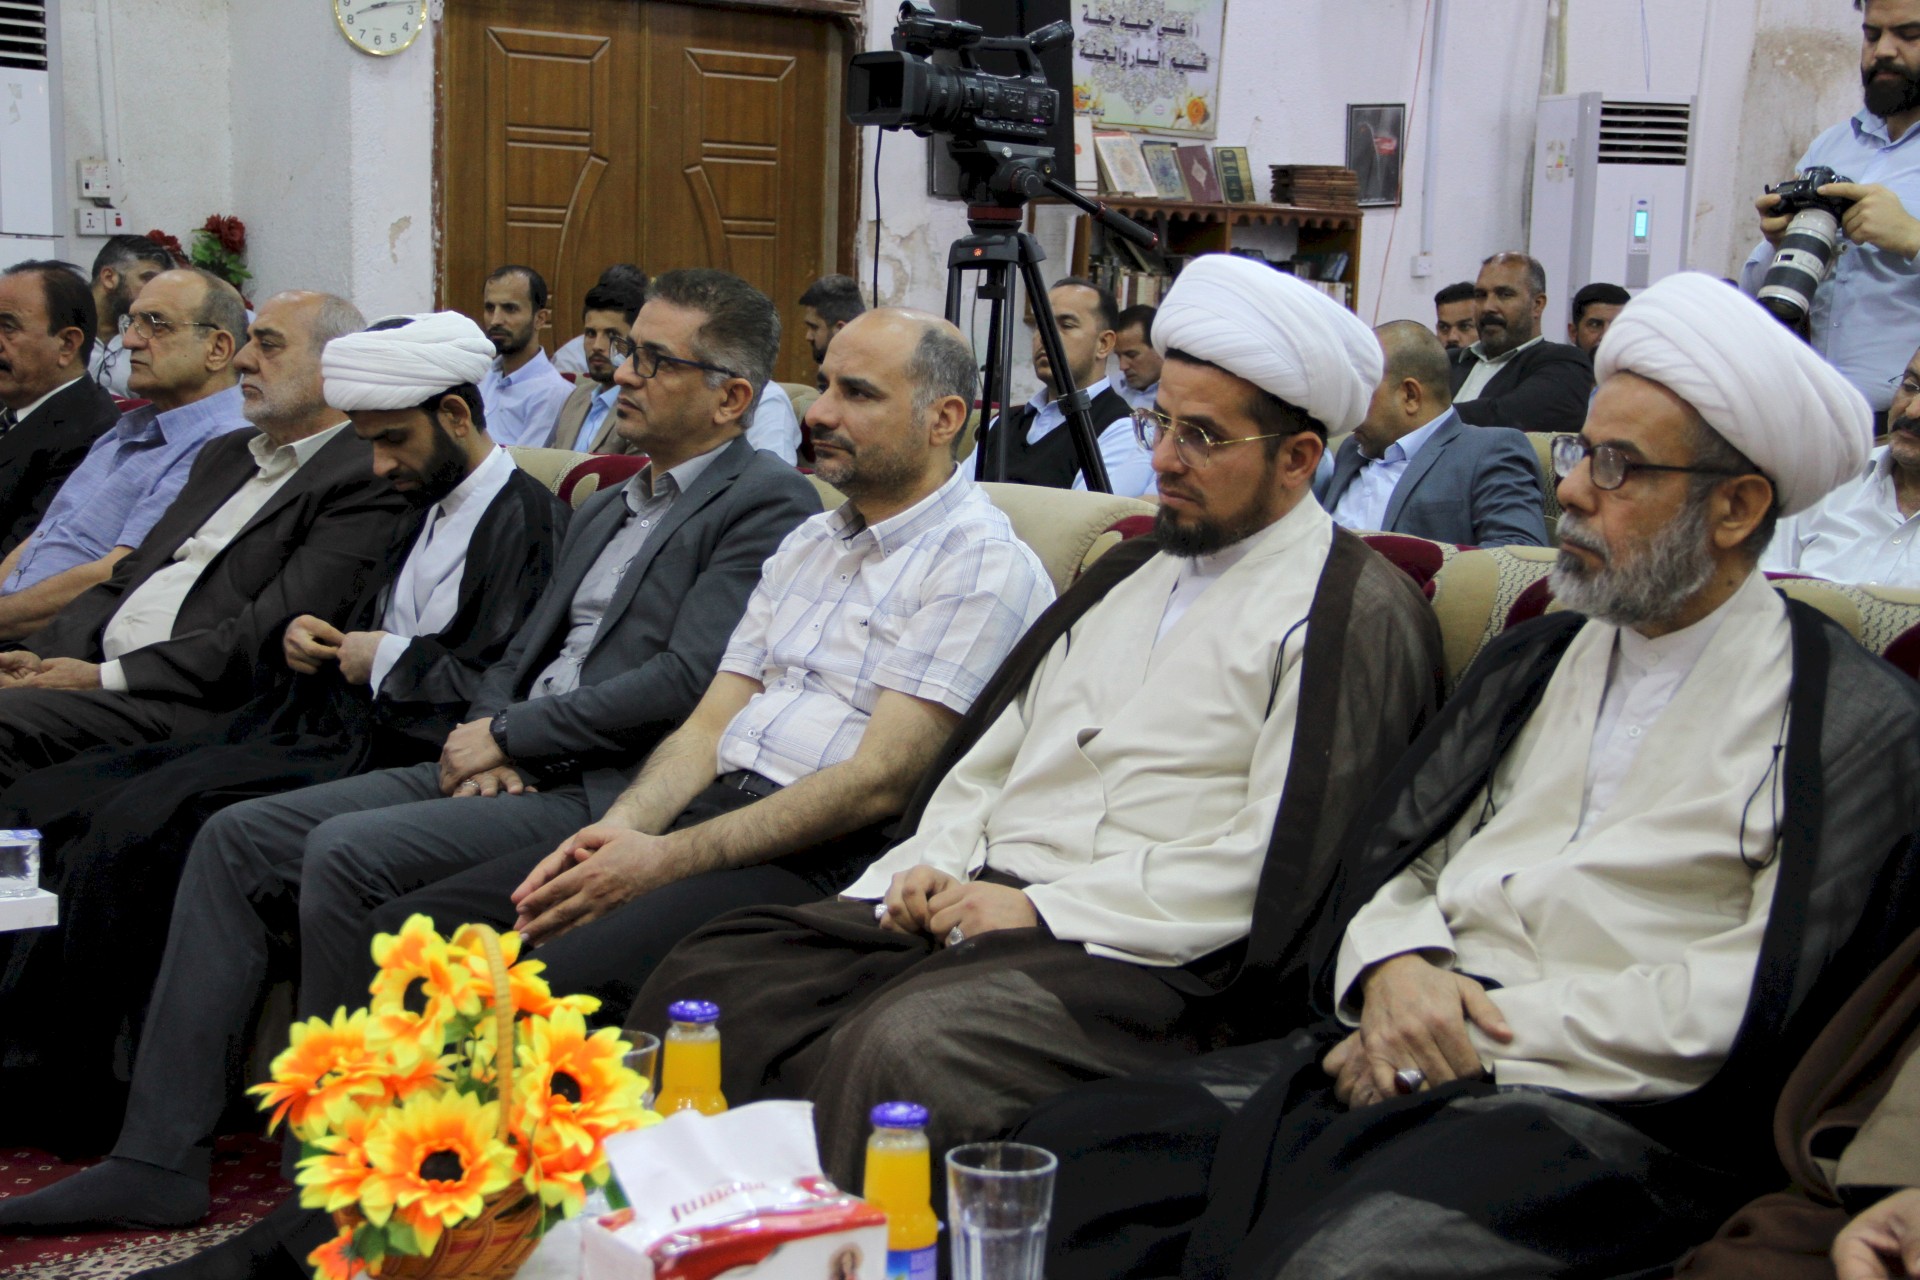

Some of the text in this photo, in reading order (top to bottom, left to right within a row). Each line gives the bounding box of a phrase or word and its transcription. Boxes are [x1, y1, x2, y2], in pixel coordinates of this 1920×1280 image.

[407, 5, 414, 15] 3
[347, 14, 354, 25] 8
[402, 22, 409, 31] 4
[359, 29, 366, 39] 7
[390, 32, 397, 43] 5
[374, 35, 381, 45] 6
